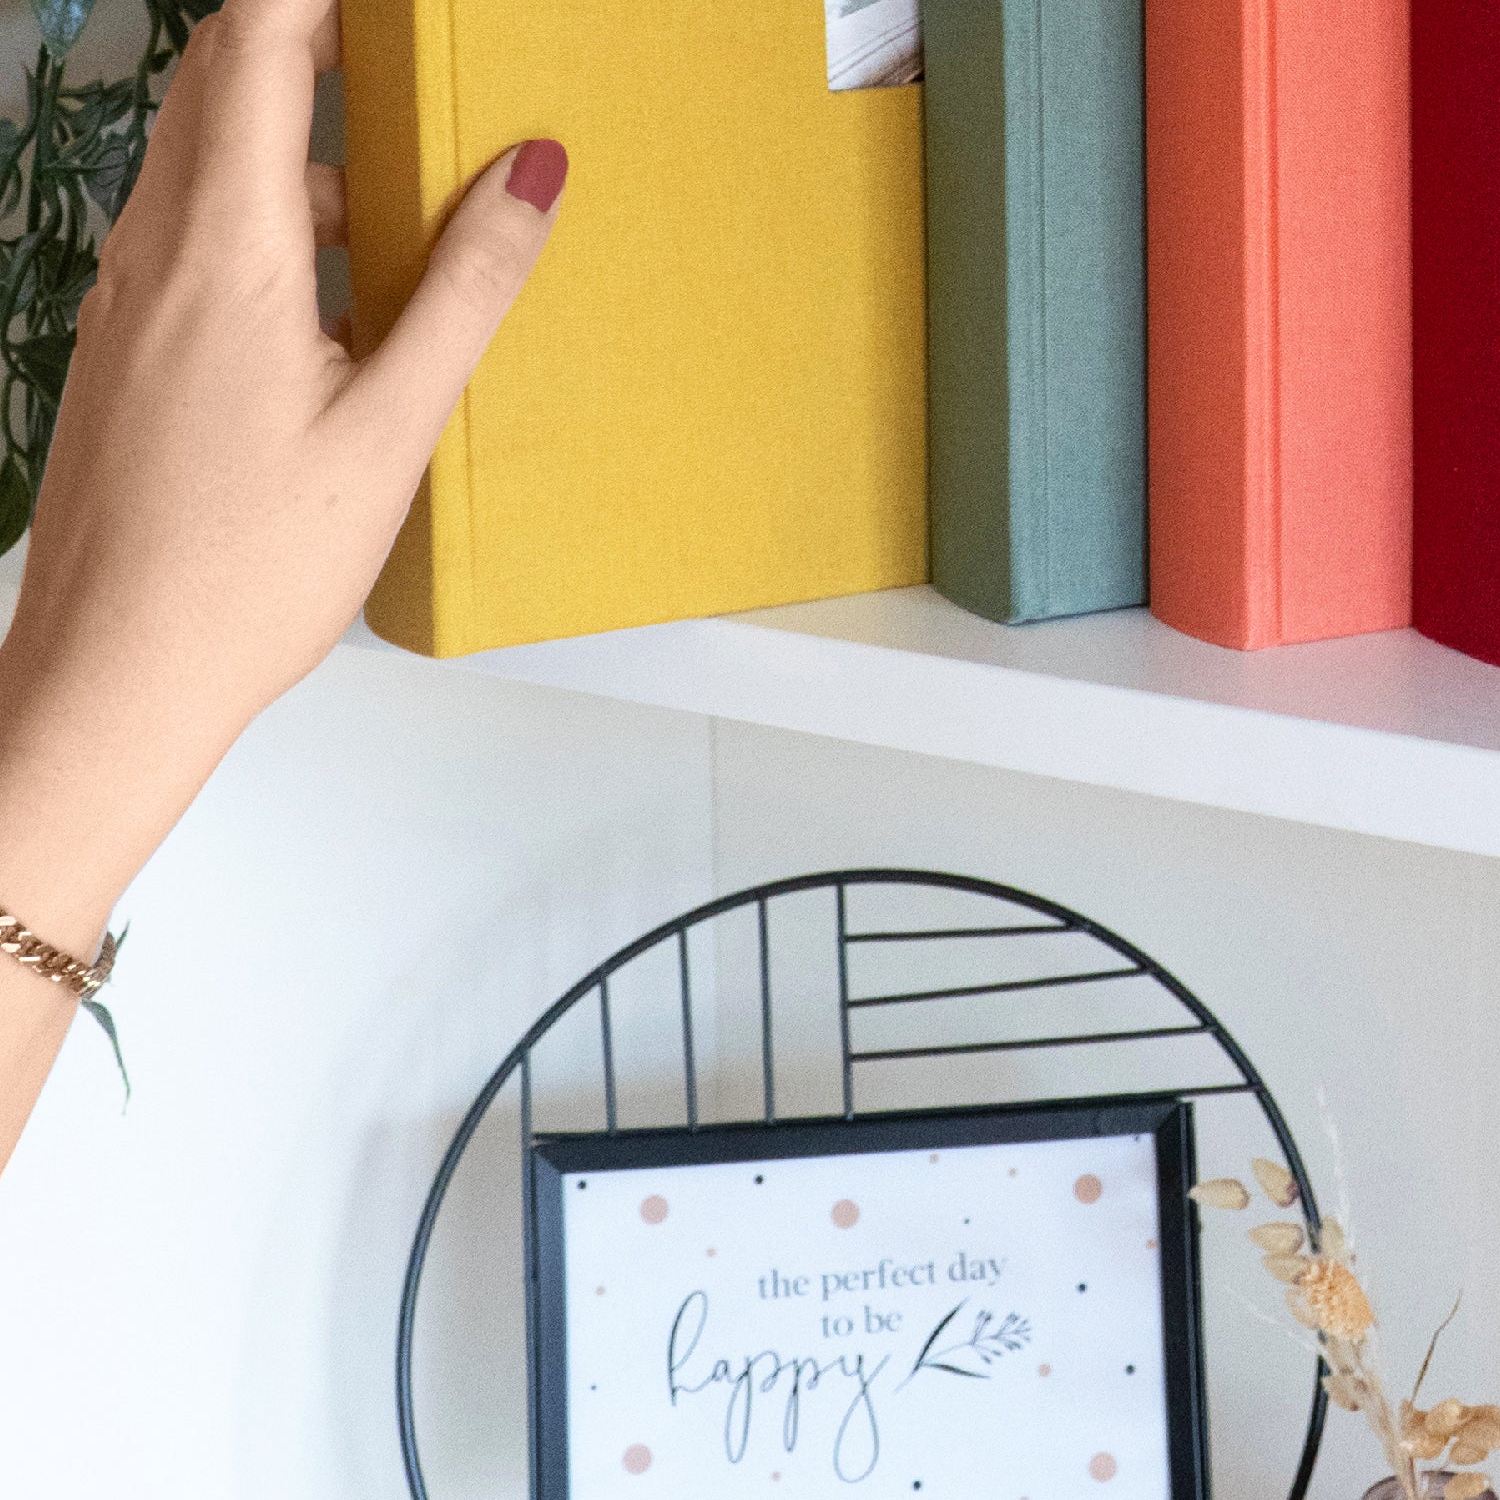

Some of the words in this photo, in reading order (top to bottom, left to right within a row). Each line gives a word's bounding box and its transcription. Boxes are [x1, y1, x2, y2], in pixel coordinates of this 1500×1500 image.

[758, 1268, 810, 1300] the
[821, 1258, 935, 1301] perfect
[949, 1251, 1008, 1287] day
[821, 1315, 854, 1338] to
[863, 1304, 903, 1335] be
[667, 1289, 893, 1484] happy
